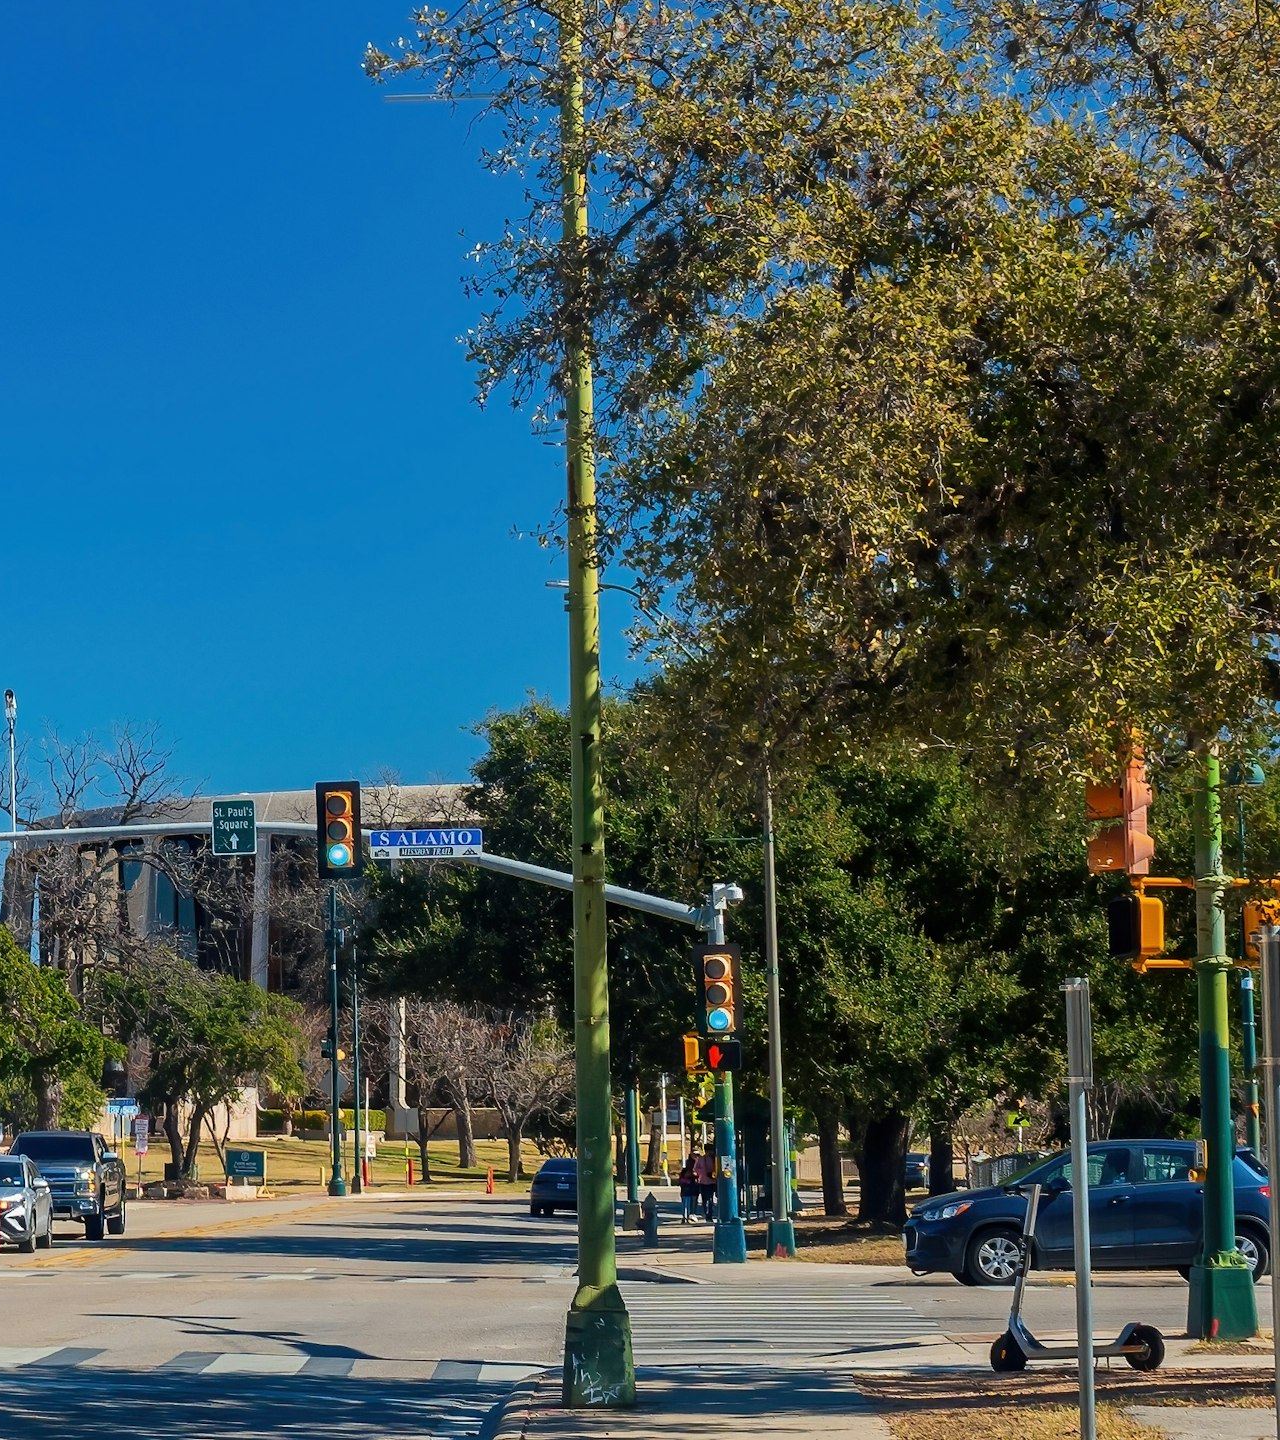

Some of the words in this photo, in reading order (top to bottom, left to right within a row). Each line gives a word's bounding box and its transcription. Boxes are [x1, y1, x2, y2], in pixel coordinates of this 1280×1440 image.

[214, 807, 225, 818] St.
[227, 806, 253, 818] Paul's
[220, 820, 249, 832] Square
[380, 831, 390, 846] S
[396, 830, 473, 846] ALAMO
[400, 847, 431, 856] MISSION
[432, 846, 453, 856] TRAIL
